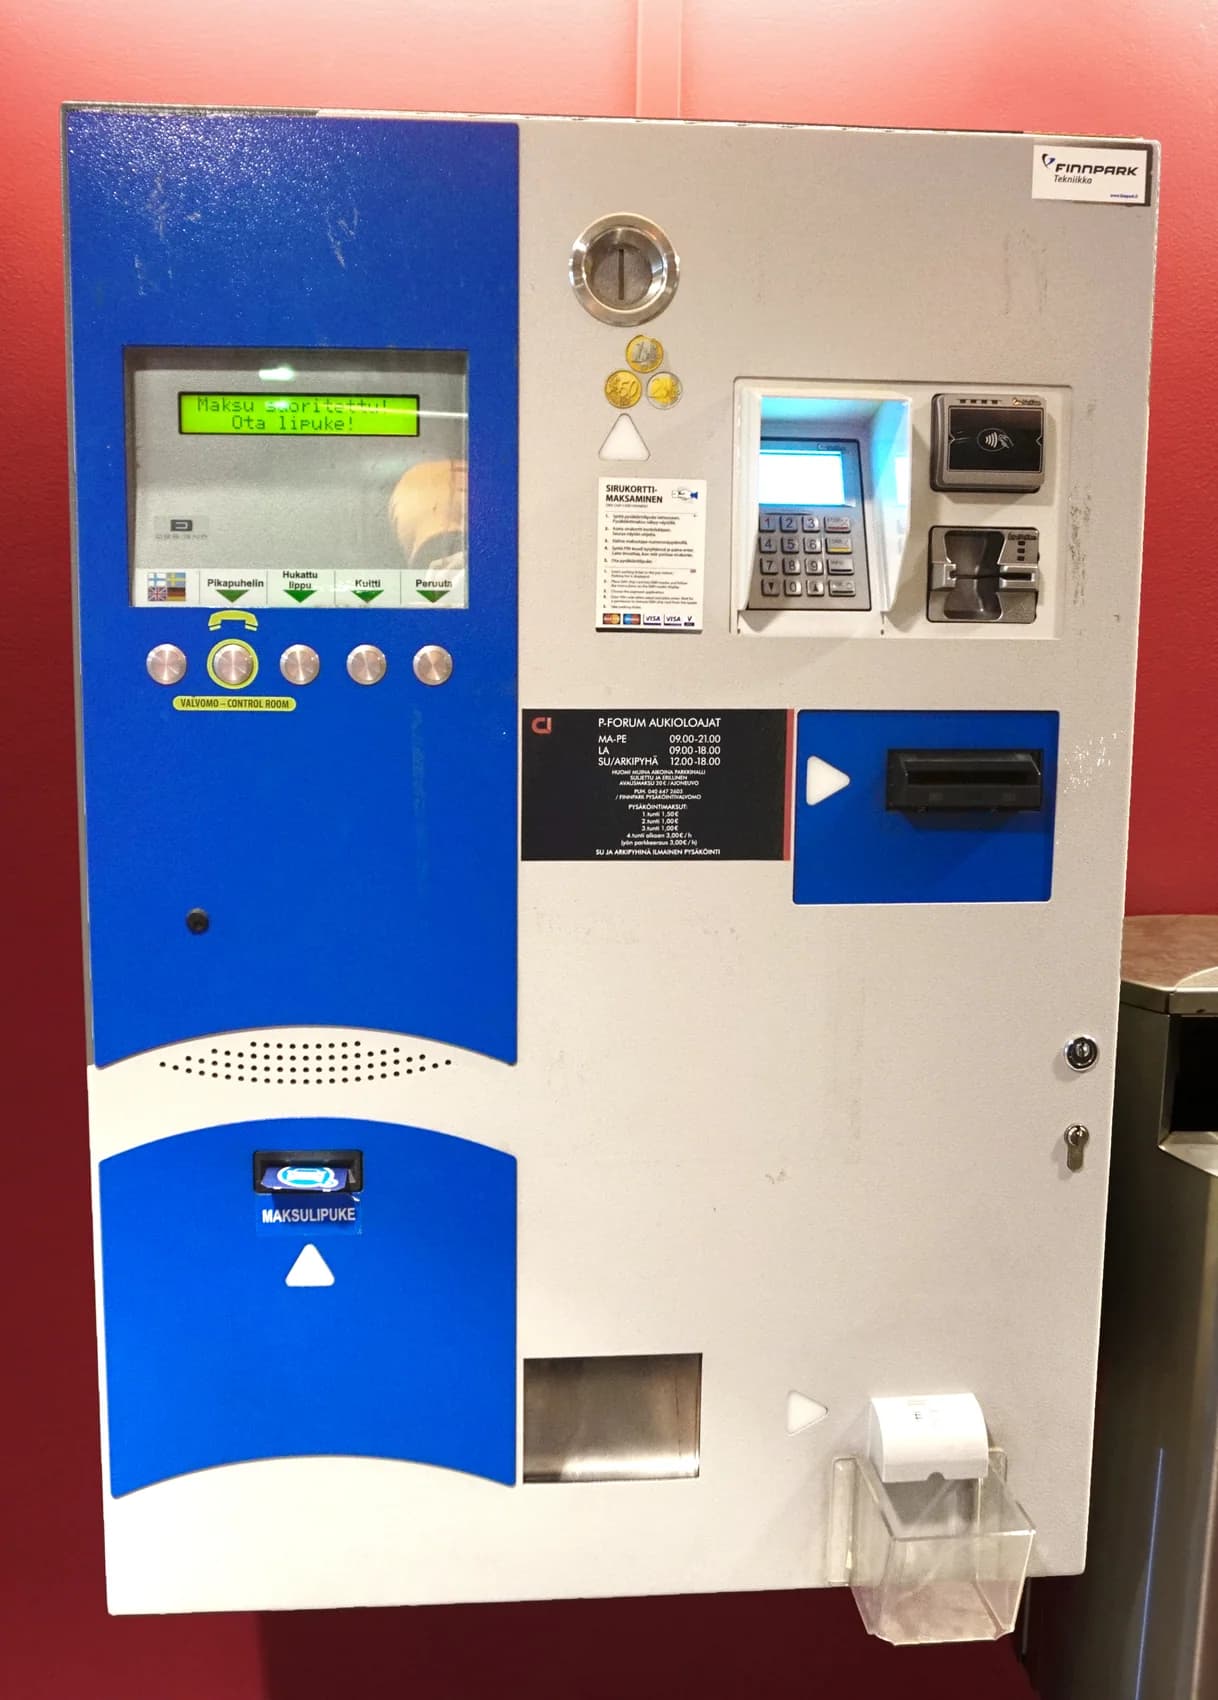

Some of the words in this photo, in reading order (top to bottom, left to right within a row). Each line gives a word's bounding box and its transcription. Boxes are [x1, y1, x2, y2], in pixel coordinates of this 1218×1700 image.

[1056, 163, 1139, 176] FINNPARK
[1054, 174, 1093, 185] Tekniikka
[197, 397, 254, 412] Maksu
[231, 416, 266, 430] Ota
[279, 416, 354, 431] lipuke!
[605, 484, 658, 493] SIRUKORTTI-
[605, 494, 663, 503] MAKSAMINEN
[764, 518, 770, 528] 1
[785, 518, 793, 528] 2
[807, 518, 815, 528] 3
[764, 539, 772, 549] 4
[787, 539, 795, 550] 5
[809, 540, 817, 550] 6
[766, 560, 773, 570] 7
[788, 560, 796, 571] 8
[810, 560, 818, 571] 9
[282, 570, 318, 579] Hukattu
[207, 578, 264, 588] Pikapuhelin
[289, 581, 312, 590] lippu
[355, 578, 382, 588] Kuitti
[789, 581, 797, 592] 0
[181, 698, 219, 708] VALVOMO
[227, 698, 263, 708] CONTROL
[265, 699, 289, 709] ROOM
[598, 717, 647, 728] P-FORUM
[648, 717, 721, 728] AUKIOLOAJAT
[598, 734, 627, 743] MA-PE
[669, 734, 721, 743] 09.00-21.00
[598, 746, 610, 755] LA
[598, 755, 659, 766] SU/ARKIPYHÄ
[262, 1207, 356, 1223] MAKSULIPUKE
